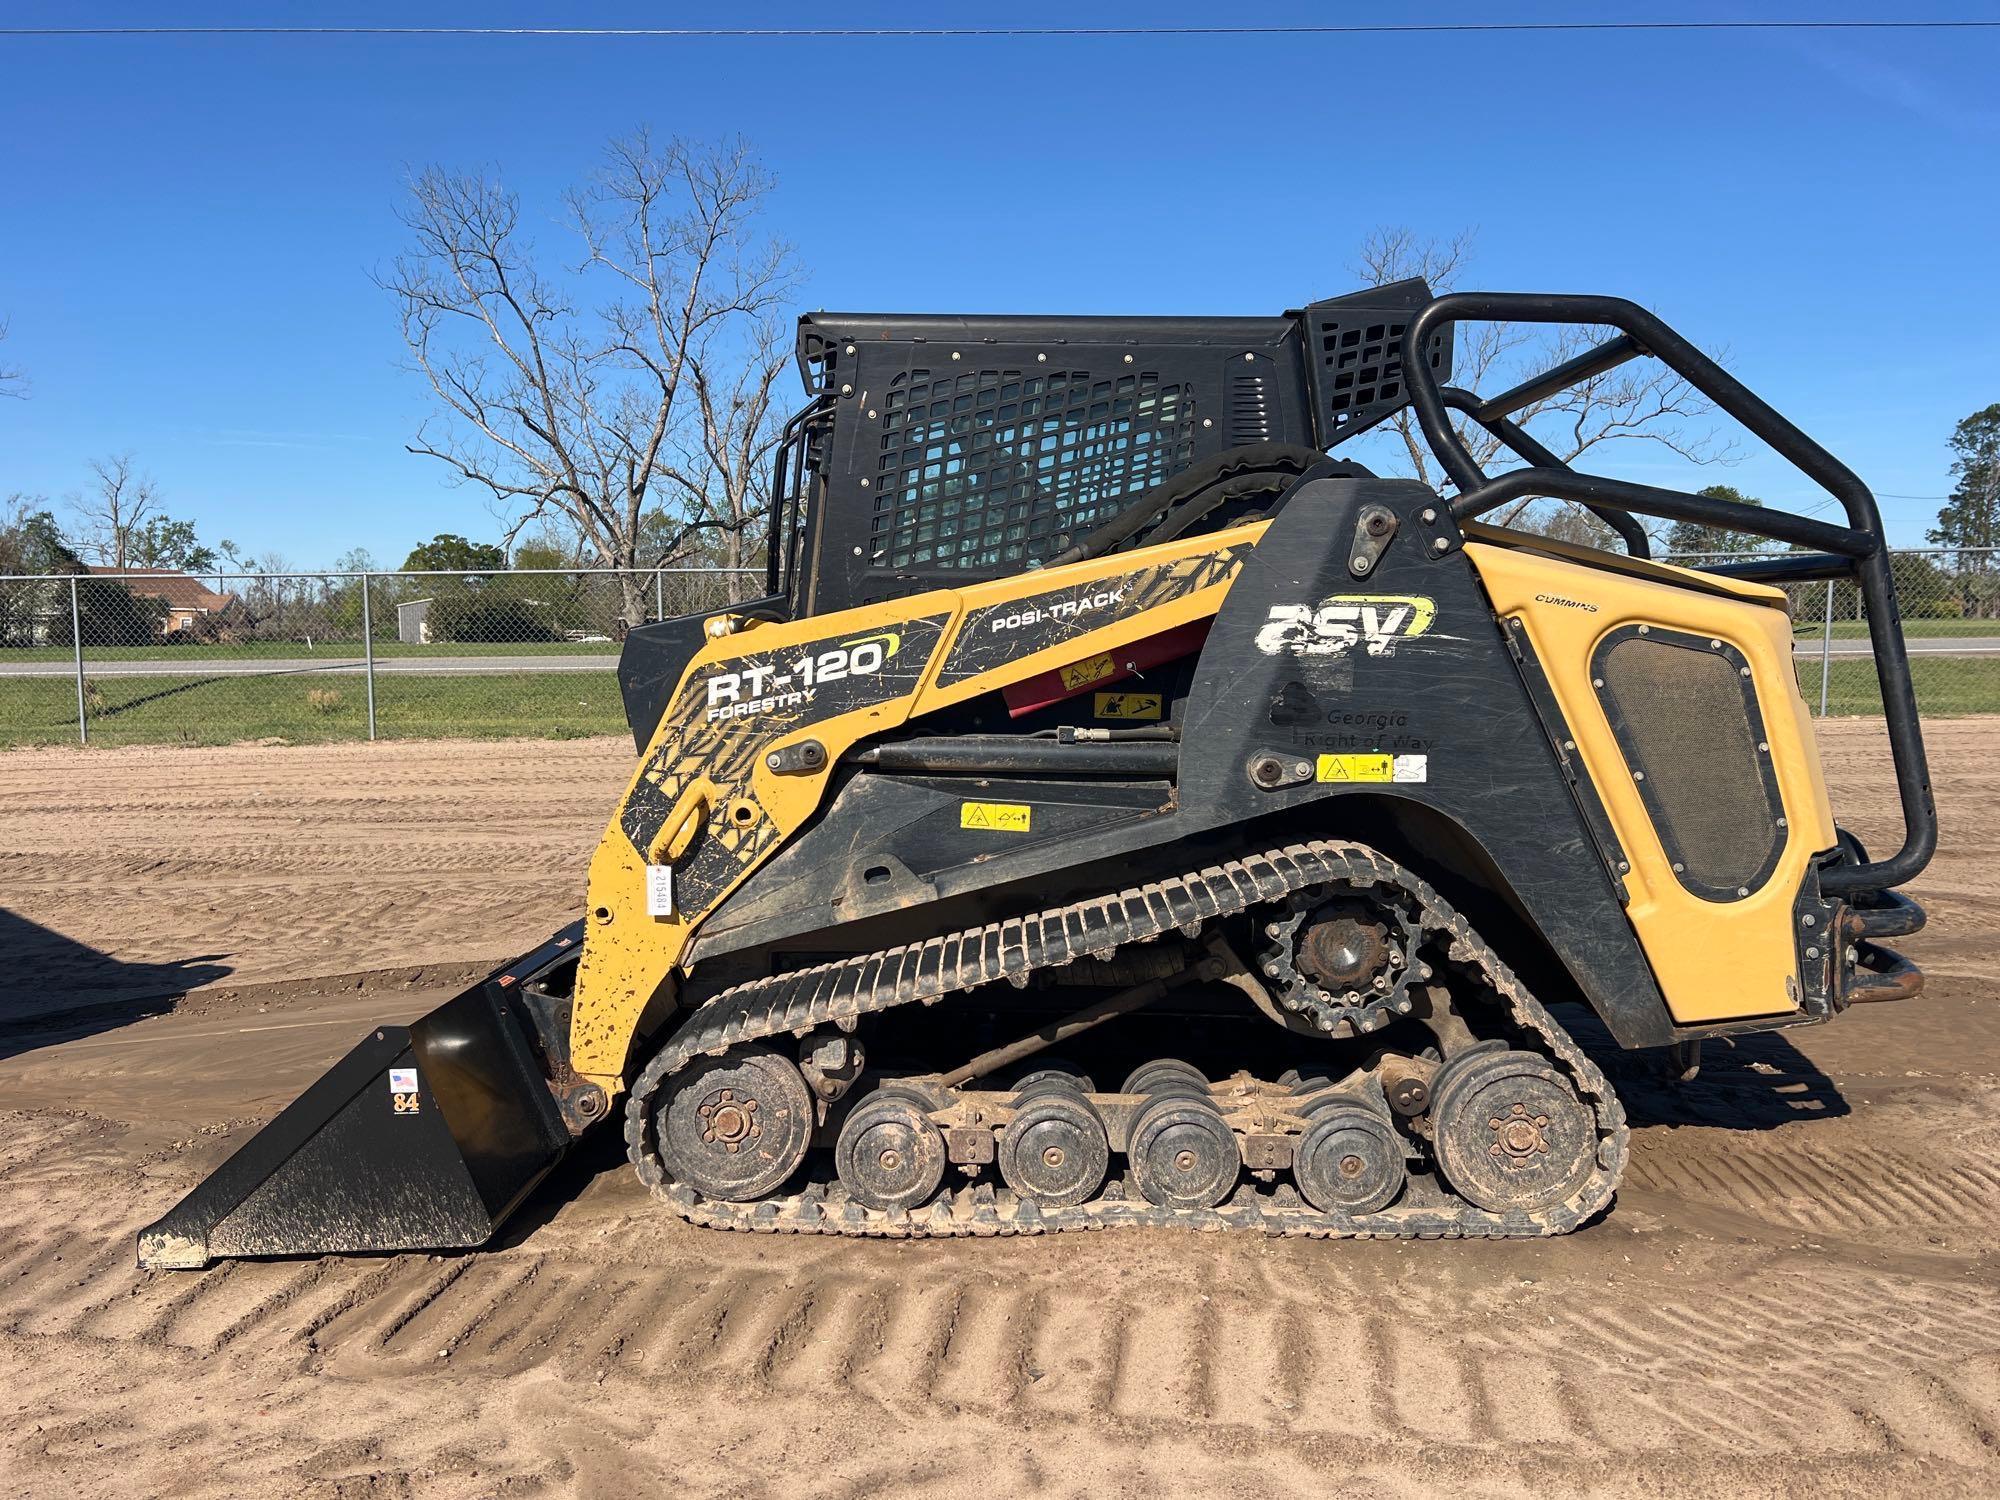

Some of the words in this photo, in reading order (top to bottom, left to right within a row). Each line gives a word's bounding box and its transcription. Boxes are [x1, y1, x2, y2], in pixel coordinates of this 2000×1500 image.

[992, 588, 1125, 633] POSI-TRACK
[1535, 594, 1599, 613] CUMMINS
[707, 643, 882, 706] RT-120
[707, 688, 817, 723] FORESTRY
[1327, 709, 1410, 730] Georgia
[1364, 733, 1388, 748] of
[1393, 734, 1434, 752] Way
[393, 1092, 420, 1112] 84
